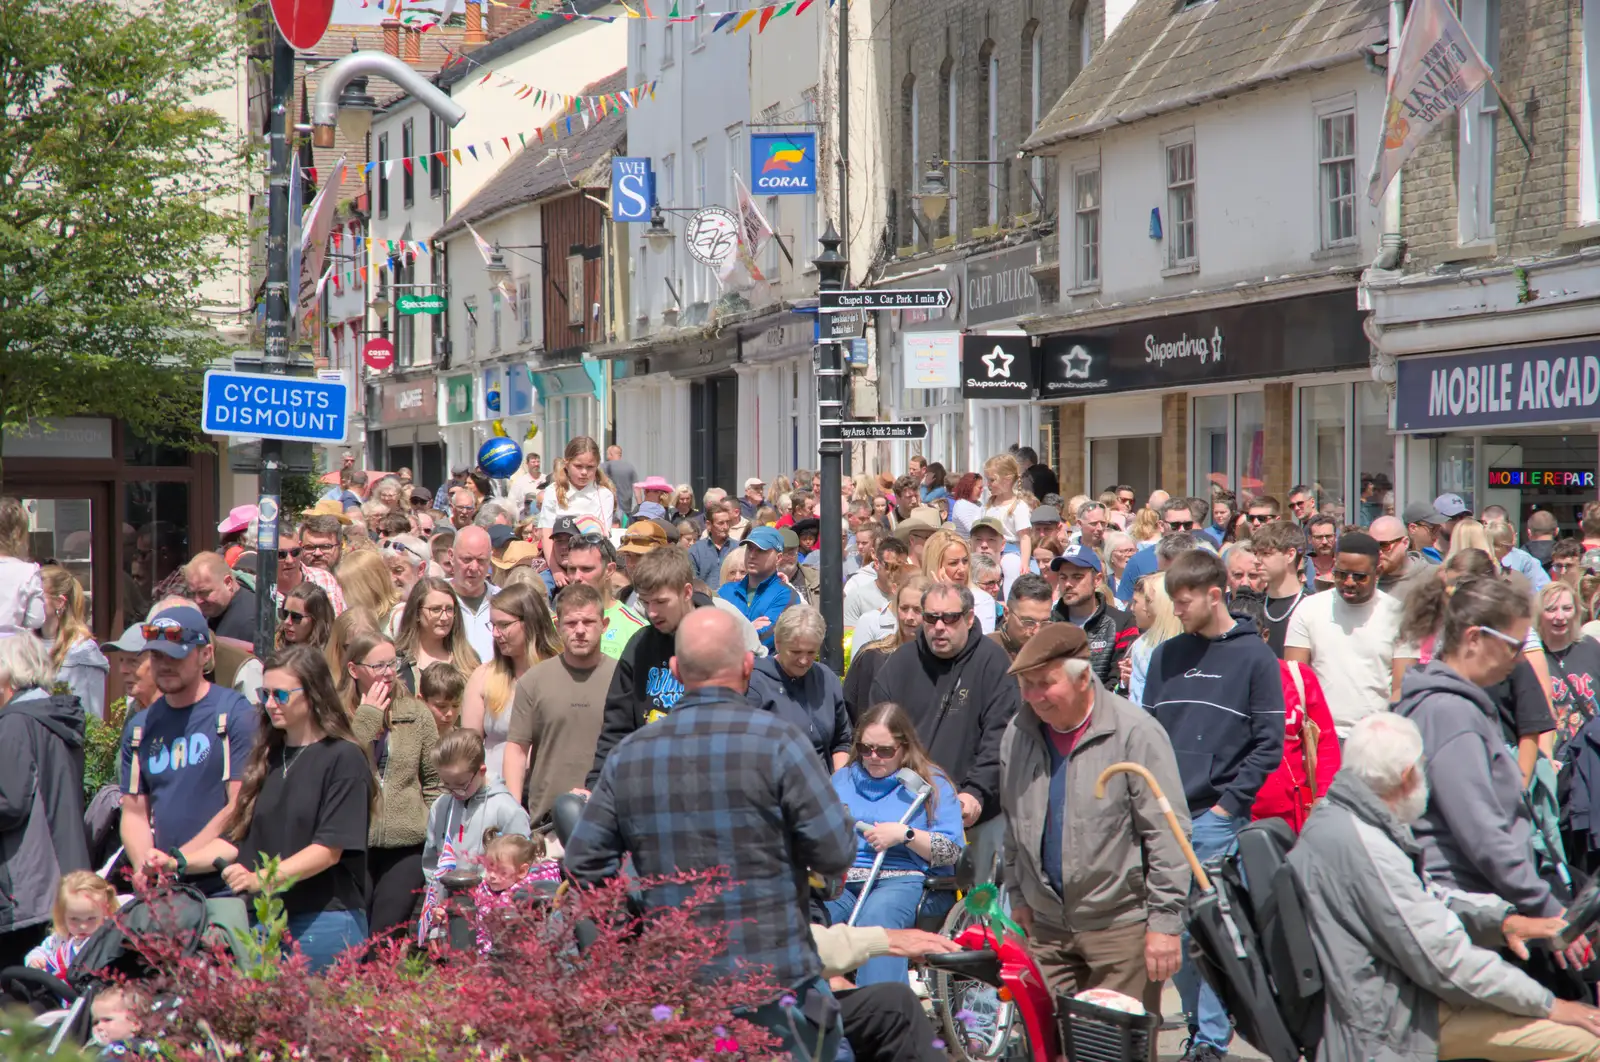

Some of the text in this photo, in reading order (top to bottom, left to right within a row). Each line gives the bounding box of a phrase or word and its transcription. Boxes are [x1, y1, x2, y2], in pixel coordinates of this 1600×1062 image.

[619, 162, 645, 174] WH
[758, 177, 809, 187] CORAL
[618, 175, 646, 217] S
[402, 300, 444, 309] Specsavers
[839, 296, 863, 306] Chapel
[865, 295, 874, 304] St.
[880, 295, 893, 304] Car
[896, 294, 912, 303] Park
[921, 294, 934, 303] min
[1145, 332, 1209, 367] Superdrug
[967, 378, 1028, 389] Superdrug
[1428, 363, 1513, 416] MOBILE
[224, 384, 329, 409] CYCLISTS
[215, 405, 338, 431] DISMOUNT
[852, 428, 865, 436] Area
[872, 427, 885, 435] Park
[886, 427, 891, 435] 2
[1489, 471, 1595, 486] MOBILE REPAIR
